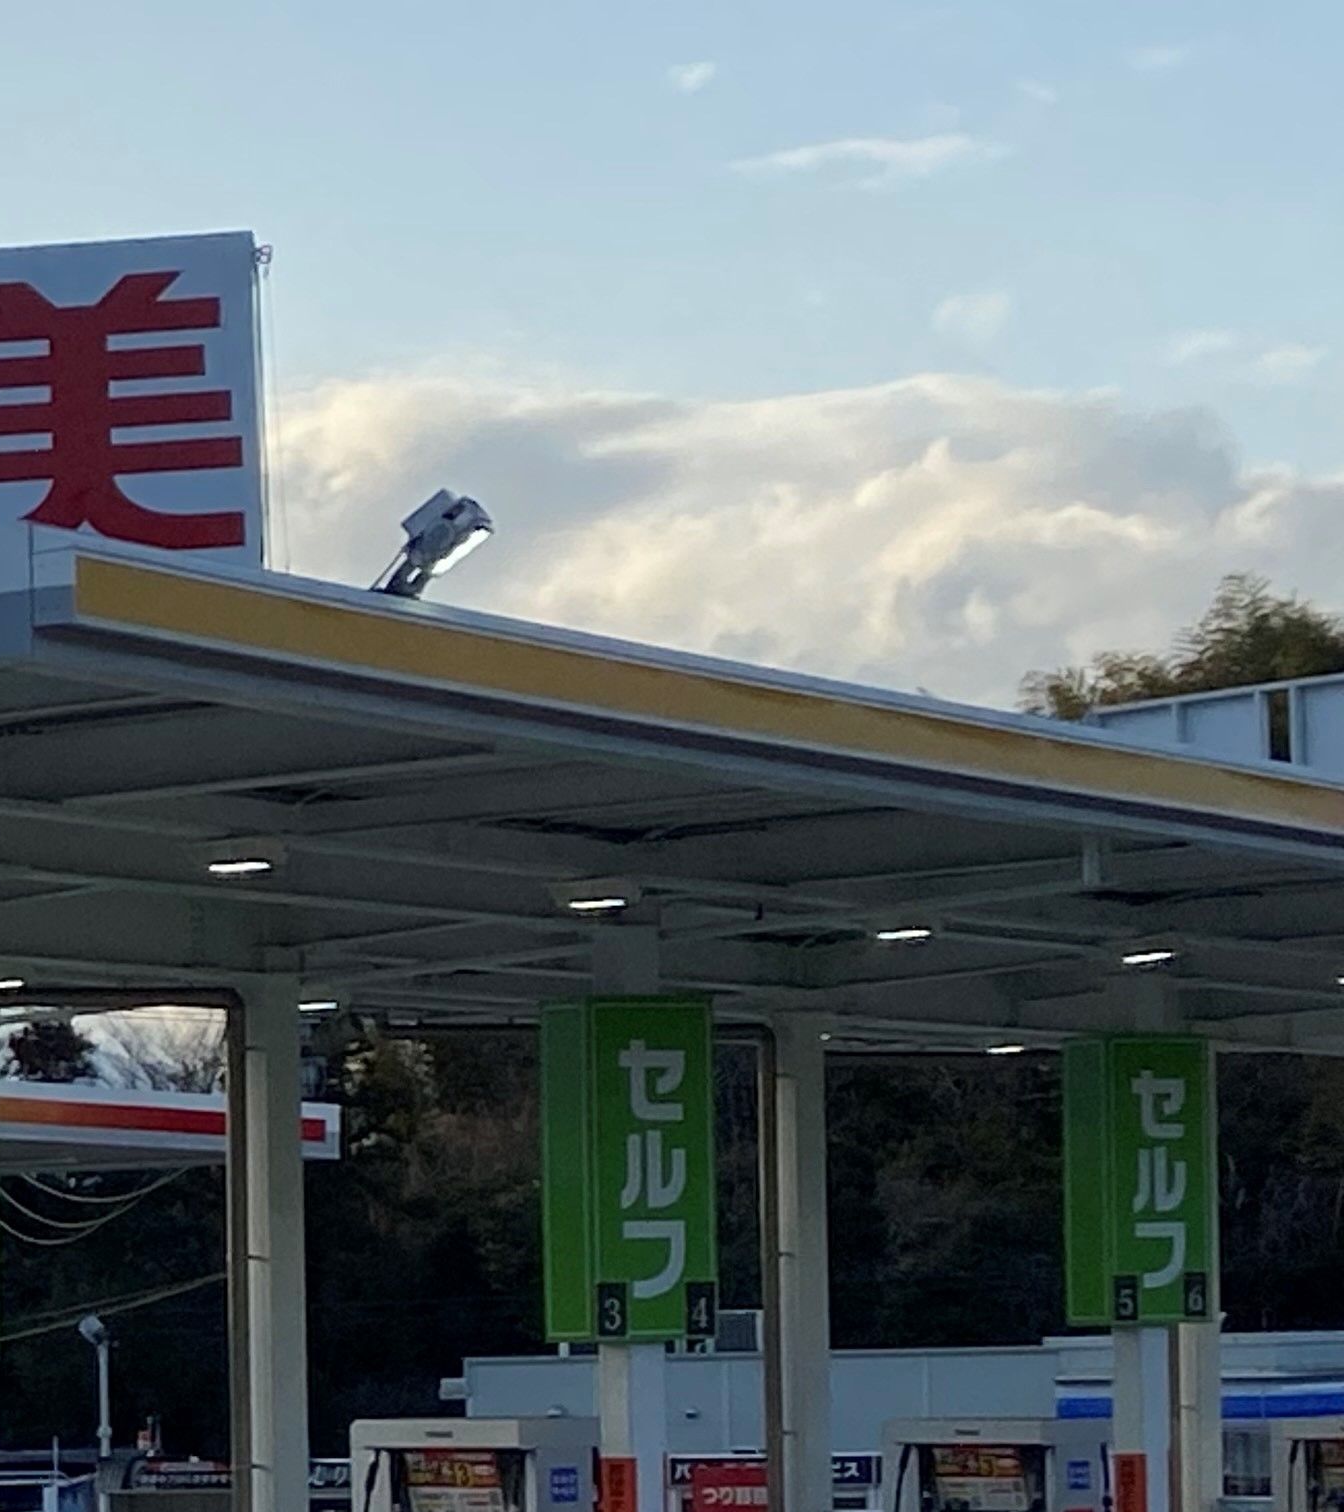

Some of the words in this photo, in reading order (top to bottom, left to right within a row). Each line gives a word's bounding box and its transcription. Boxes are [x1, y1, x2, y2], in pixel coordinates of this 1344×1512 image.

[618, 1038, 687, 1299] セルフ
[1130, 1069, 1188, 1289] セルフ
[603, 1297, 623, 1331] 3
[691, 1296, 709, 1330] 4
[1117, 1288, 1135, 1317] 5
[1187, 1285, 1204, 1313] 6
